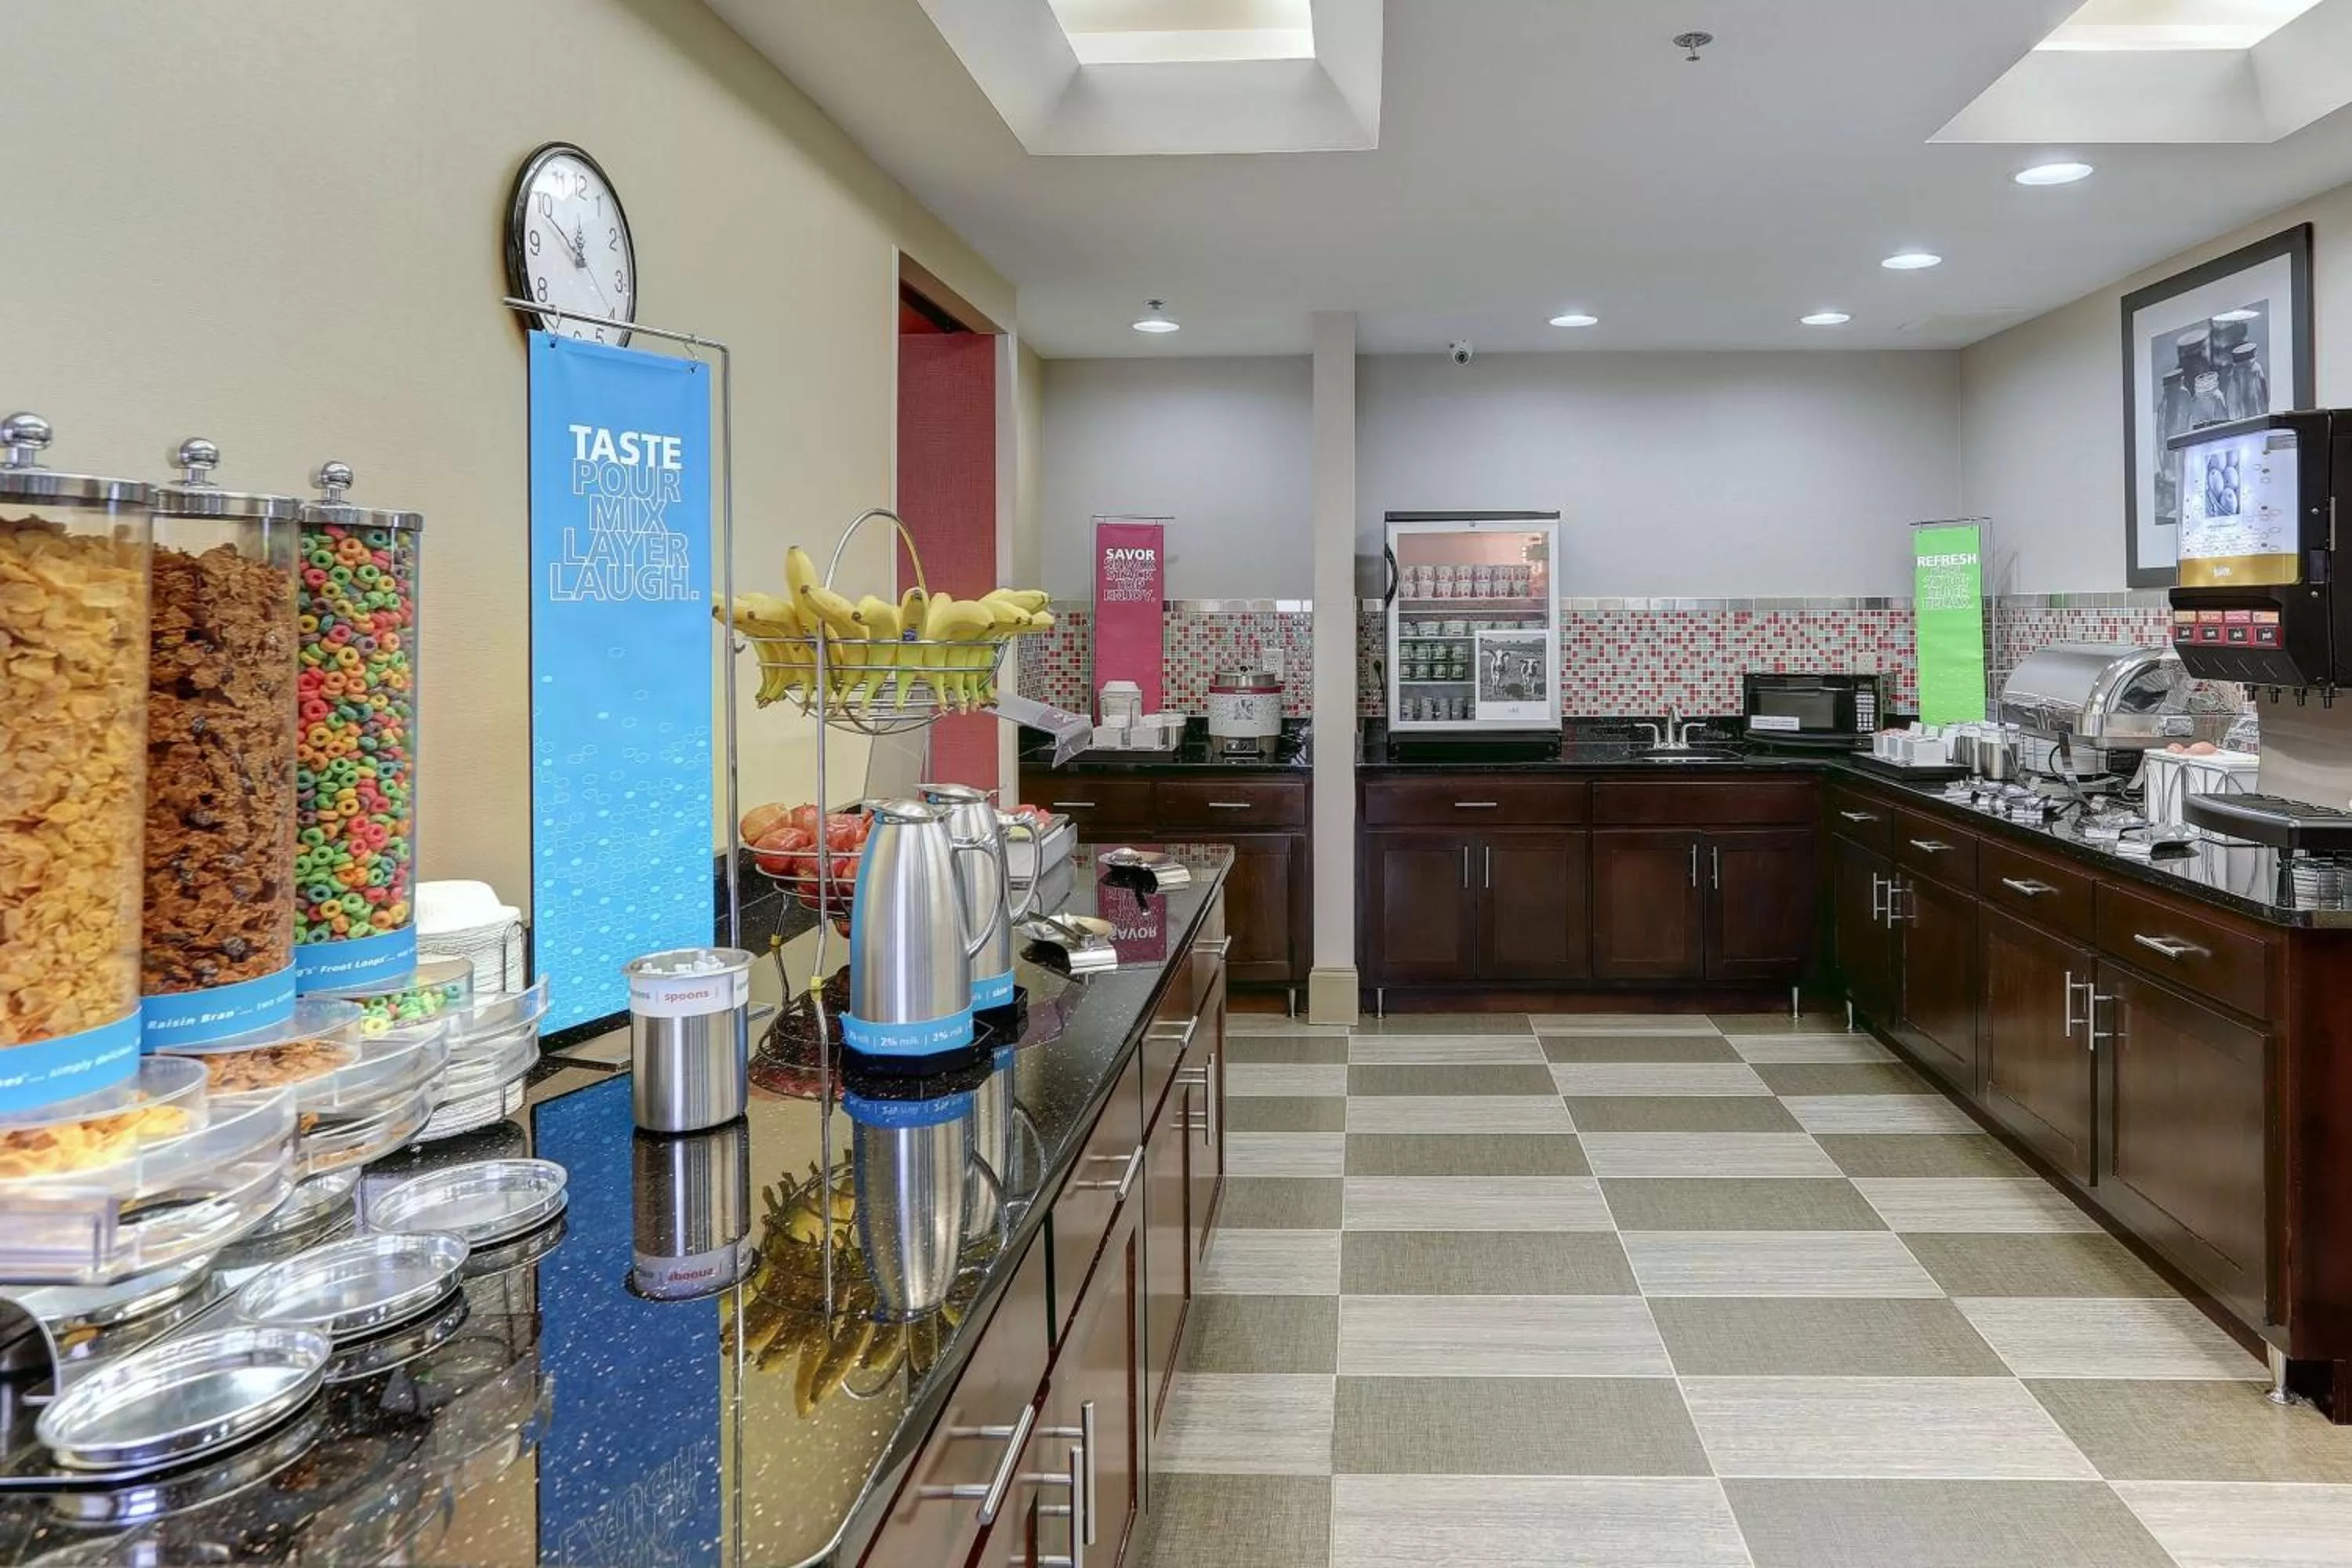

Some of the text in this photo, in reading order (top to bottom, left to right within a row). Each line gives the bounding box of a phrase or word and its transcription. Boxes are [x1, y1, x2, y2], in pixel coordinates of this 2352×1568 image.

[552, 172, 565, 197] 11
[573, 172, 588, 201] 12
[537, 191, 553, 217] 10
[595, 195, 602, 217] 1
[529, 230, 540, 256] 9
[608, 227, 617, 251] 2
[537, 277, 548, 303] 8
[614, 270, 623, 293] 3
[594, 328, 604, 345] 5
[568, 424, 683, 470] TASTE
[572, 457, 681, 502] POUR
[589, 494, 666, 533] MIX
[564, 527, 689, 568] LAYER
[1106, 549, 1156, 561] SAVOR
[1917, 553, 1976, 568] REFRESH
[550, 562, 700, 601] LAUGH.
[664, 989, 710, 1004] spoons
[147, 1017, 195, 1029] Raisin
[201, 1010, 234, 1023] Bran
[880, 1036, 898, 1047] 2%
[931, 1031, 949, 1042] 2%
